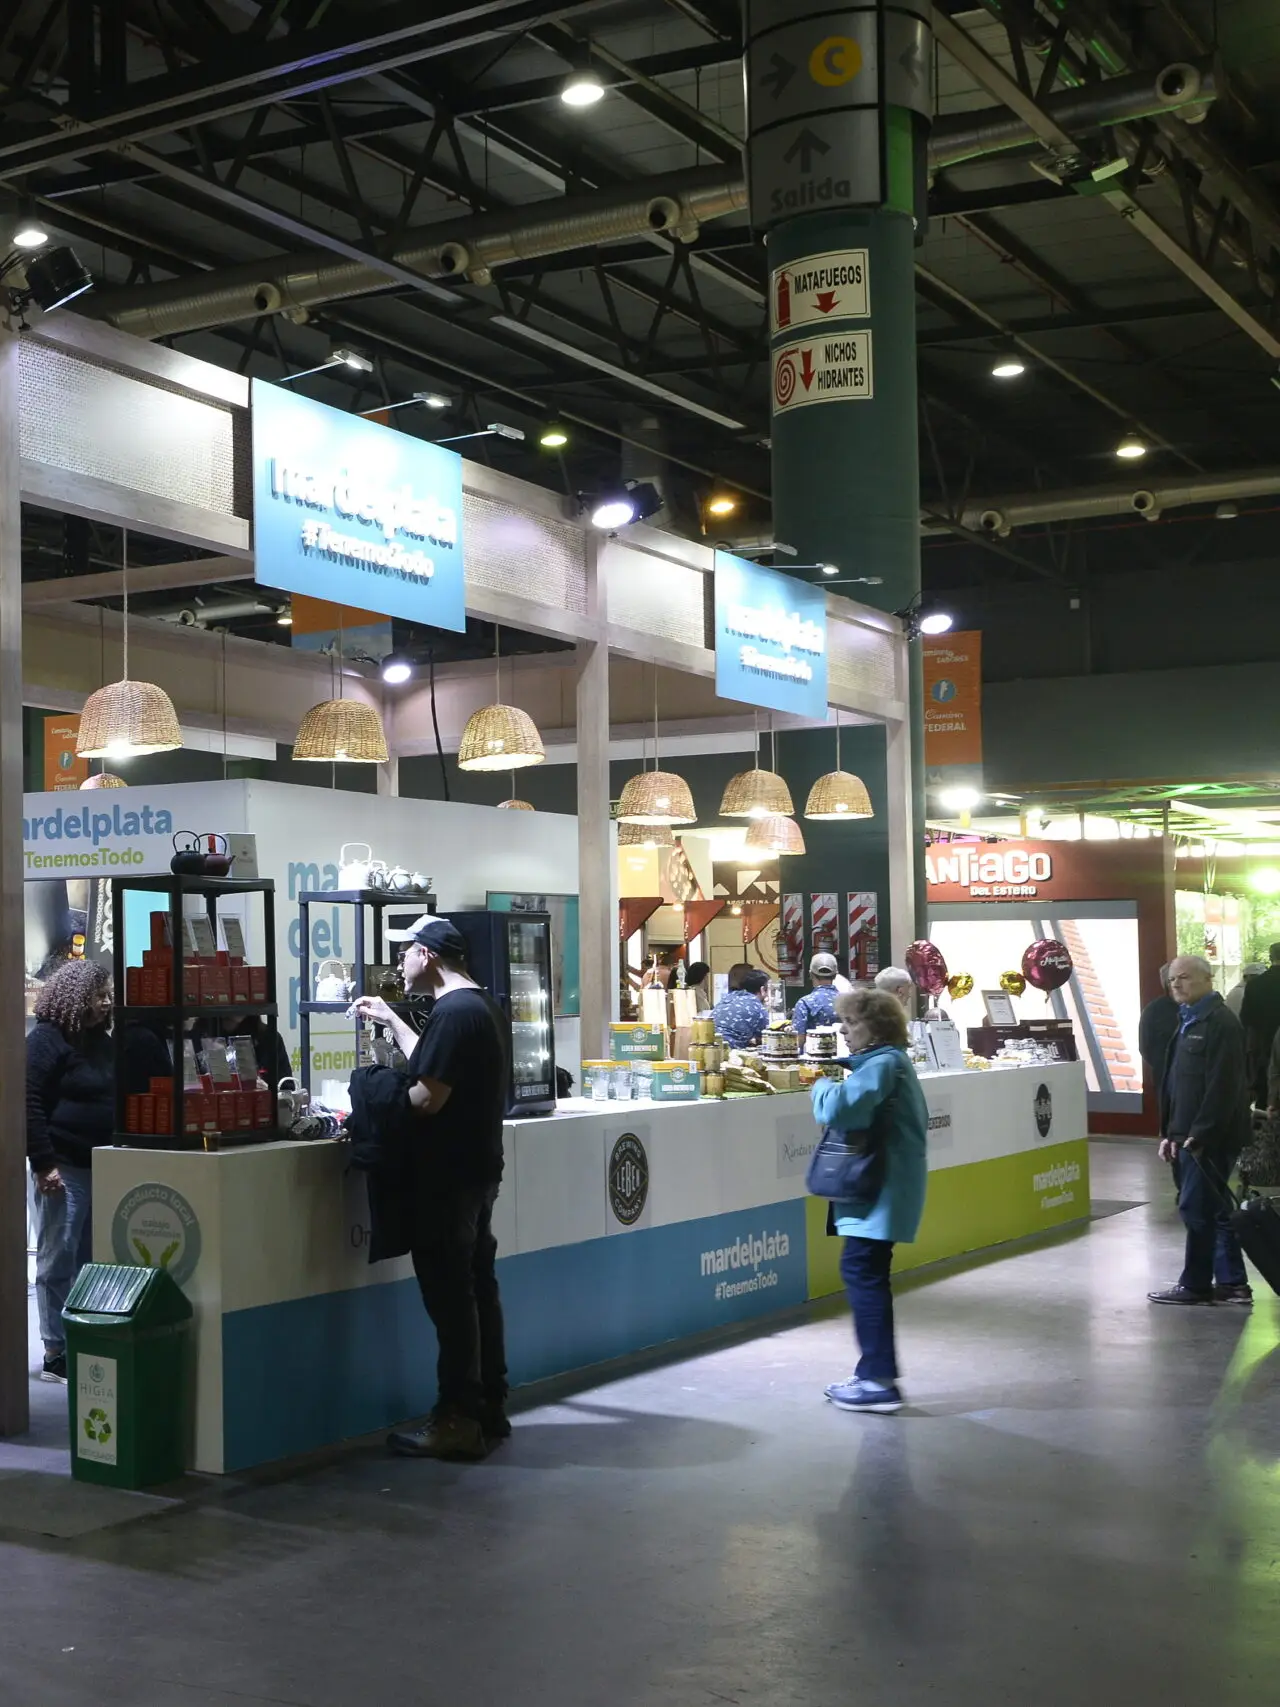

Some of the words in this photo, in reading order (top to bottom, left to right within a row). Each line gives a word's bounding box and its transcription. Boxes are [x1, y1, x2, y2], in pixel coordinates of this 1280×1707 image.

[770, 176, 852, 213] Salida
[794, 262, 862, 294] MATAFUEGOS
[824, 341, 857, 363] NICHOS
[817, 365, 864, 391] HIDRANTES
[270, 456, 457, 550] mardelplata
[23, 804, 173, 846] rdelplata
[24, 847, 145, 868] TenemosTodo
[120, 1188, 168, 1220] producto
[170, 1193, 195, 1226] local
[700, 1230, 789, 1278] mardelplata
[715, 1270, 778, 1301] #TenemosTodo
[80, 1383, 114, 1399] HIGIA
